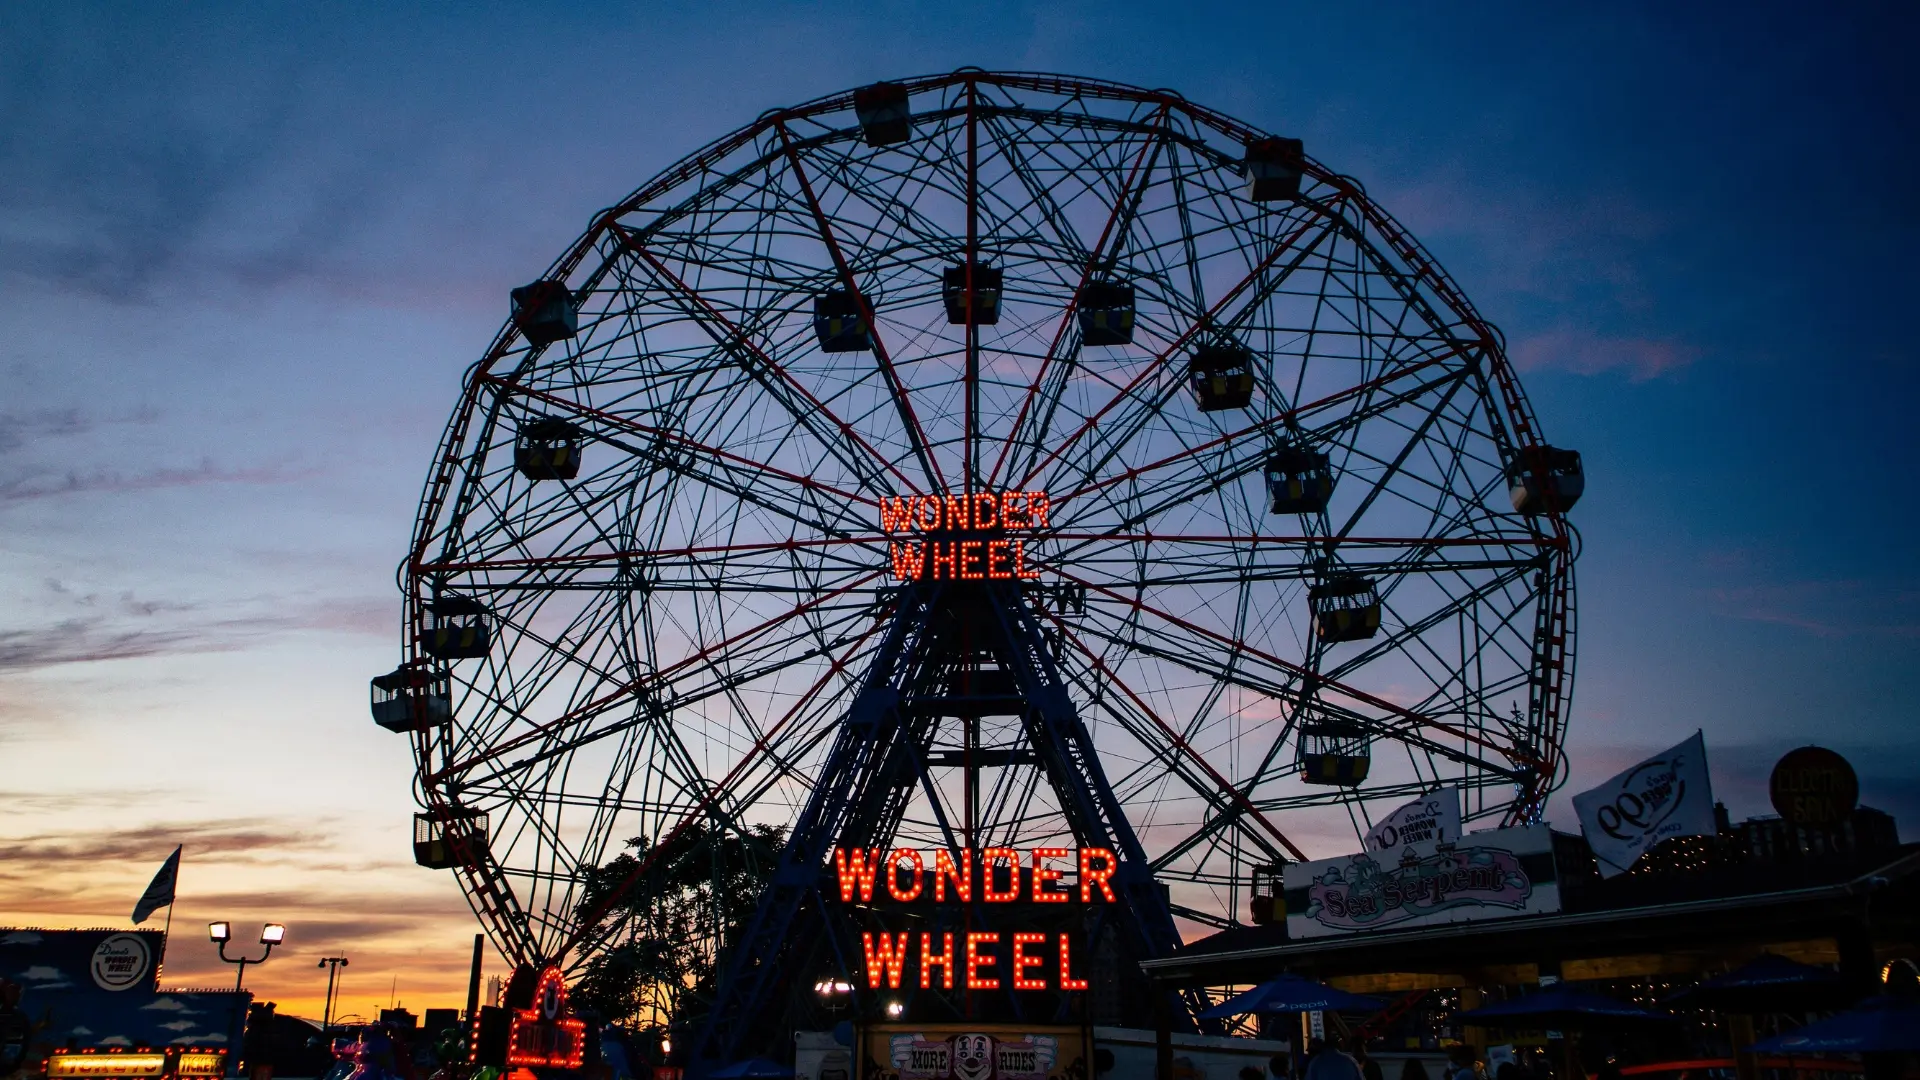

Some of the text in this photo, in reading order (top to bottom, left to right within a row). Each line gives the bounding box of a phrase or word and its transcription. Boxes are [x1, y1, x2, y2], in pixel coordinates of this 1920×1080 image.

[879, 492, 1050, 532] WONDER
[890, 540, 1041, 580] WHEEL
[834, 846, 1118, 903] WONDER
[1324, 863, 1506, 918] Sea Serpent
[861, 930, 1090, 991] WHEEL
[911, 1051, 1036, 1072] MORE RIDES
